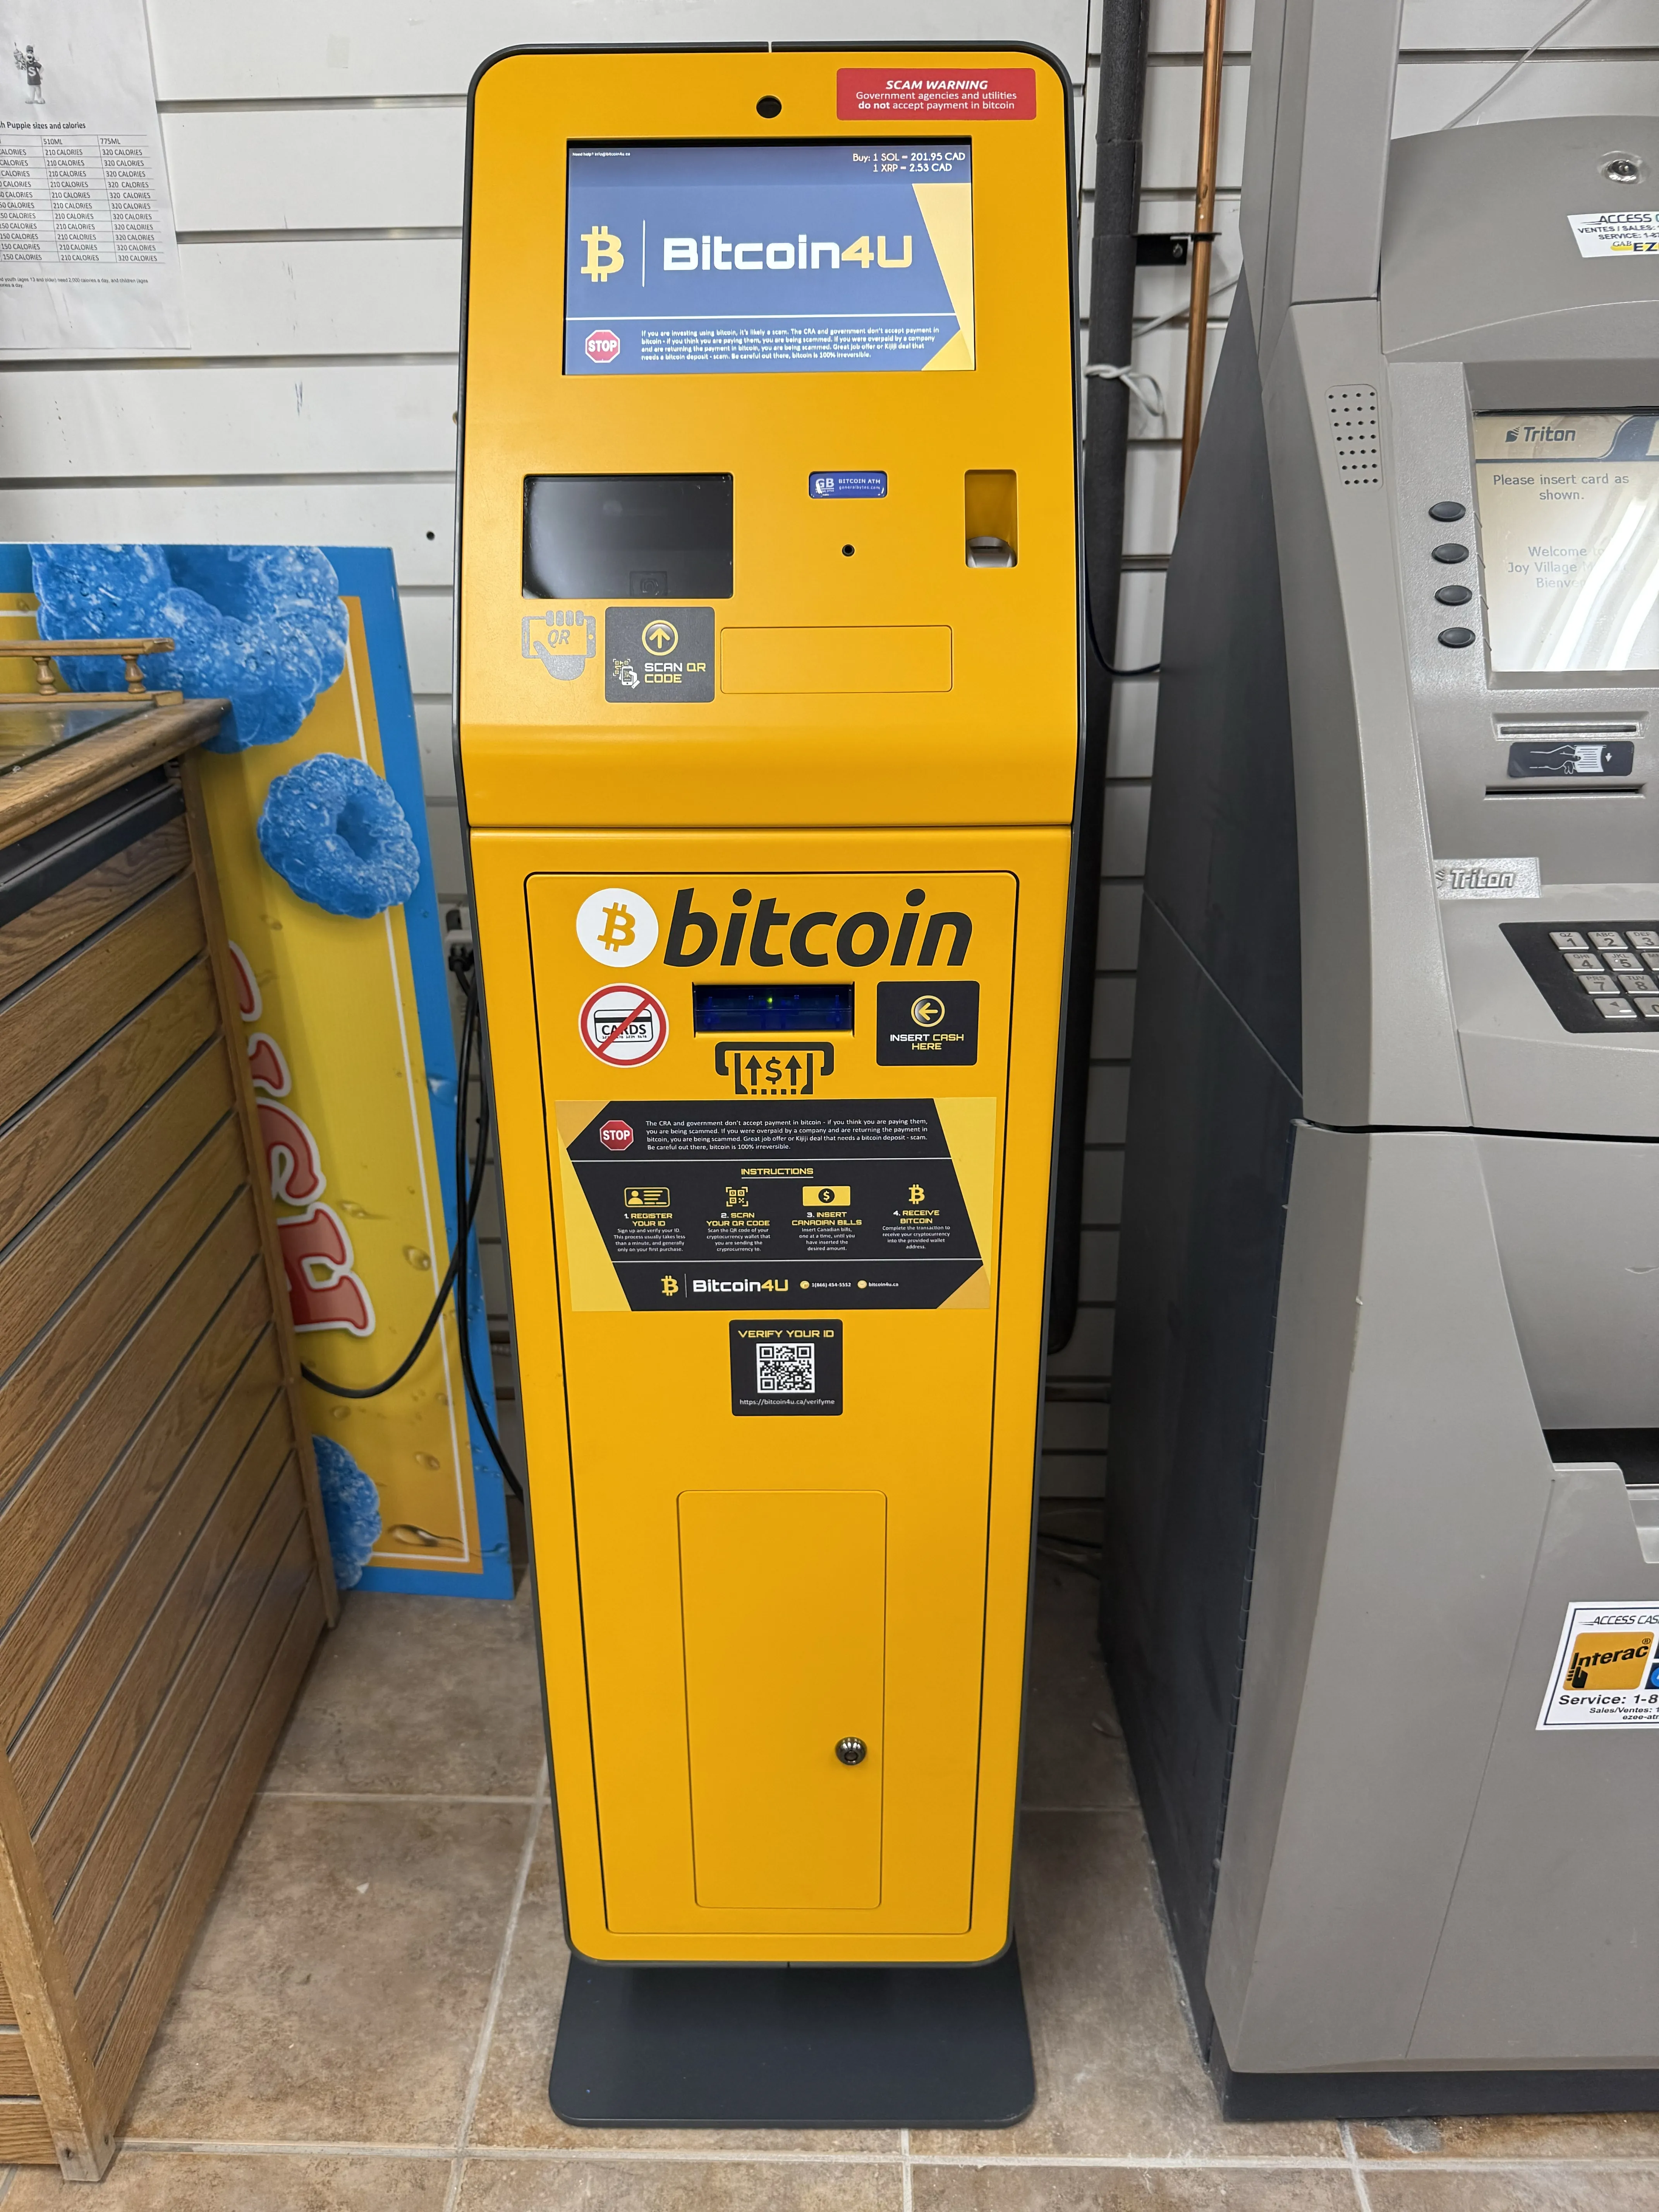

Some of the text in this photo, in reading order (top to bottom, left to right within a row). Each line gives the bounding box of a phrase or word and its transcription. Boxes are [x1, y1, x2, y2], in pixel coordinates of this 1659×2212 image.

[886, 80, 988, 90] SCAM WARNING
[856, 91, 1017, 101] Government agencies and utilities
[858, 101, 871, 109] do
[893, 102, 924, 111] accept
[927, 102, 969, 111] payment
[982, 101, 1014, 109] bitcoin
[7, 122, 31, 130] Puppie
[853, 153, 871, 163] Buy:
[873, 153, 878, 161] 1
[881, 153, 900, 161] SOL
[911, 152, 943, 161] 201.95
[945, 152, 965, 161] CAD
[873, 163, 878, 172] 1
[881, 163, 898, 172] XRP
[909, 163, 929, 172] 2.53
[931, 163, 952, 172] CAD
[1599, 213, 1652, 224] ACCESS
[663, 234, 912, 271] Bitcoin4U
[587, 339, 618, 353] STOP
[1523, 426, 1576, 442] Triton
[1493, 474, 1535, 486] Please
[1540, 474, 1577, 485] insert
[1582, 473, 1608, 484] card
[1539, 489, 1584, 500] shown.
[1527, 546, 1587, 557] Welcome
[1508, 562, 1530, 575] Joy
[1534, 561, 1577, 574] Village
[547, 629, 570, 647] QR
[644, 663, 706, 672] SCAN QR
[644, 674, 682, 683] CODE
[1451, 869, 1515, 889] Triton
[663, 888, 972, 967] bitcoin
[1566, 938, 1577, 947] 1
[1604, 938, 1618, 946] 2
[1642, 937, 1655, 946] 3
[1582, 960, 1594, 968] 4
[1620, 959, 1632, 967] 5
[1593, 982, 1605, 991] 7
[1635, 981, 1648, 991] 8
[603, 1130, 630, 1140] STOP
[693, 1278, 788, 1292] Bitcoin4U
[1593, 1615, 1659, 1625] ACCESS CAS
[1571, 1645, 1649, 1669] Interac
[1559, 1694, 1626, 1705] Service:
